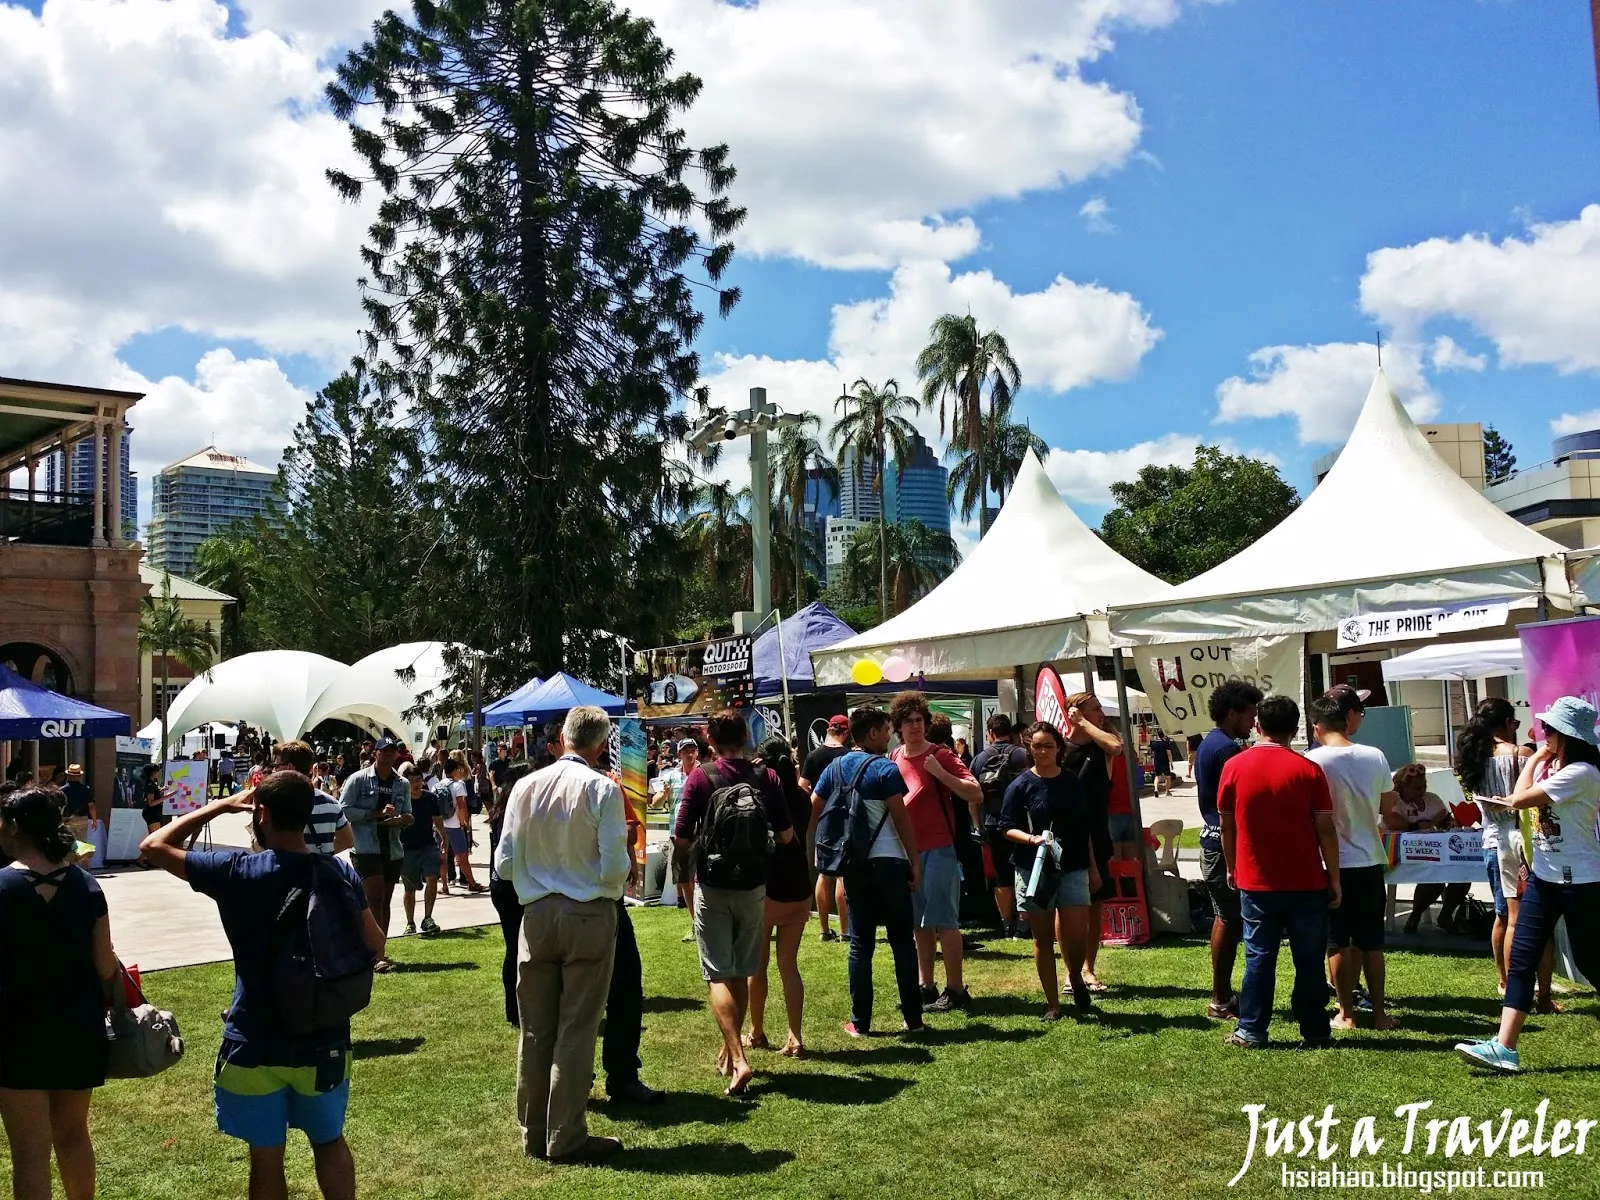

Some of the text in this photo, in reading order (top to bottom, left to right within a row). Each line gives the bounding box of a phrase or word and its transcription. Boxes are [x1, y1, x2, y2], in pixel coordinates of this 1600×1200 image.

[1368, 619, 1390, 637] THE
[1396, 614, 1433, 633] PRIDE
[703, 640, 733, 664] QUT
[1190, 645, 1232, 662] QUT
[703, 660, 747, 674] MOTORSPORT
[1162, 691, 1207, 720] Coll
[40, 719, 86, 738] QUT
[1424, 840, 1442, 848] WEEK
[1435, 848, 1440, 856] 3
